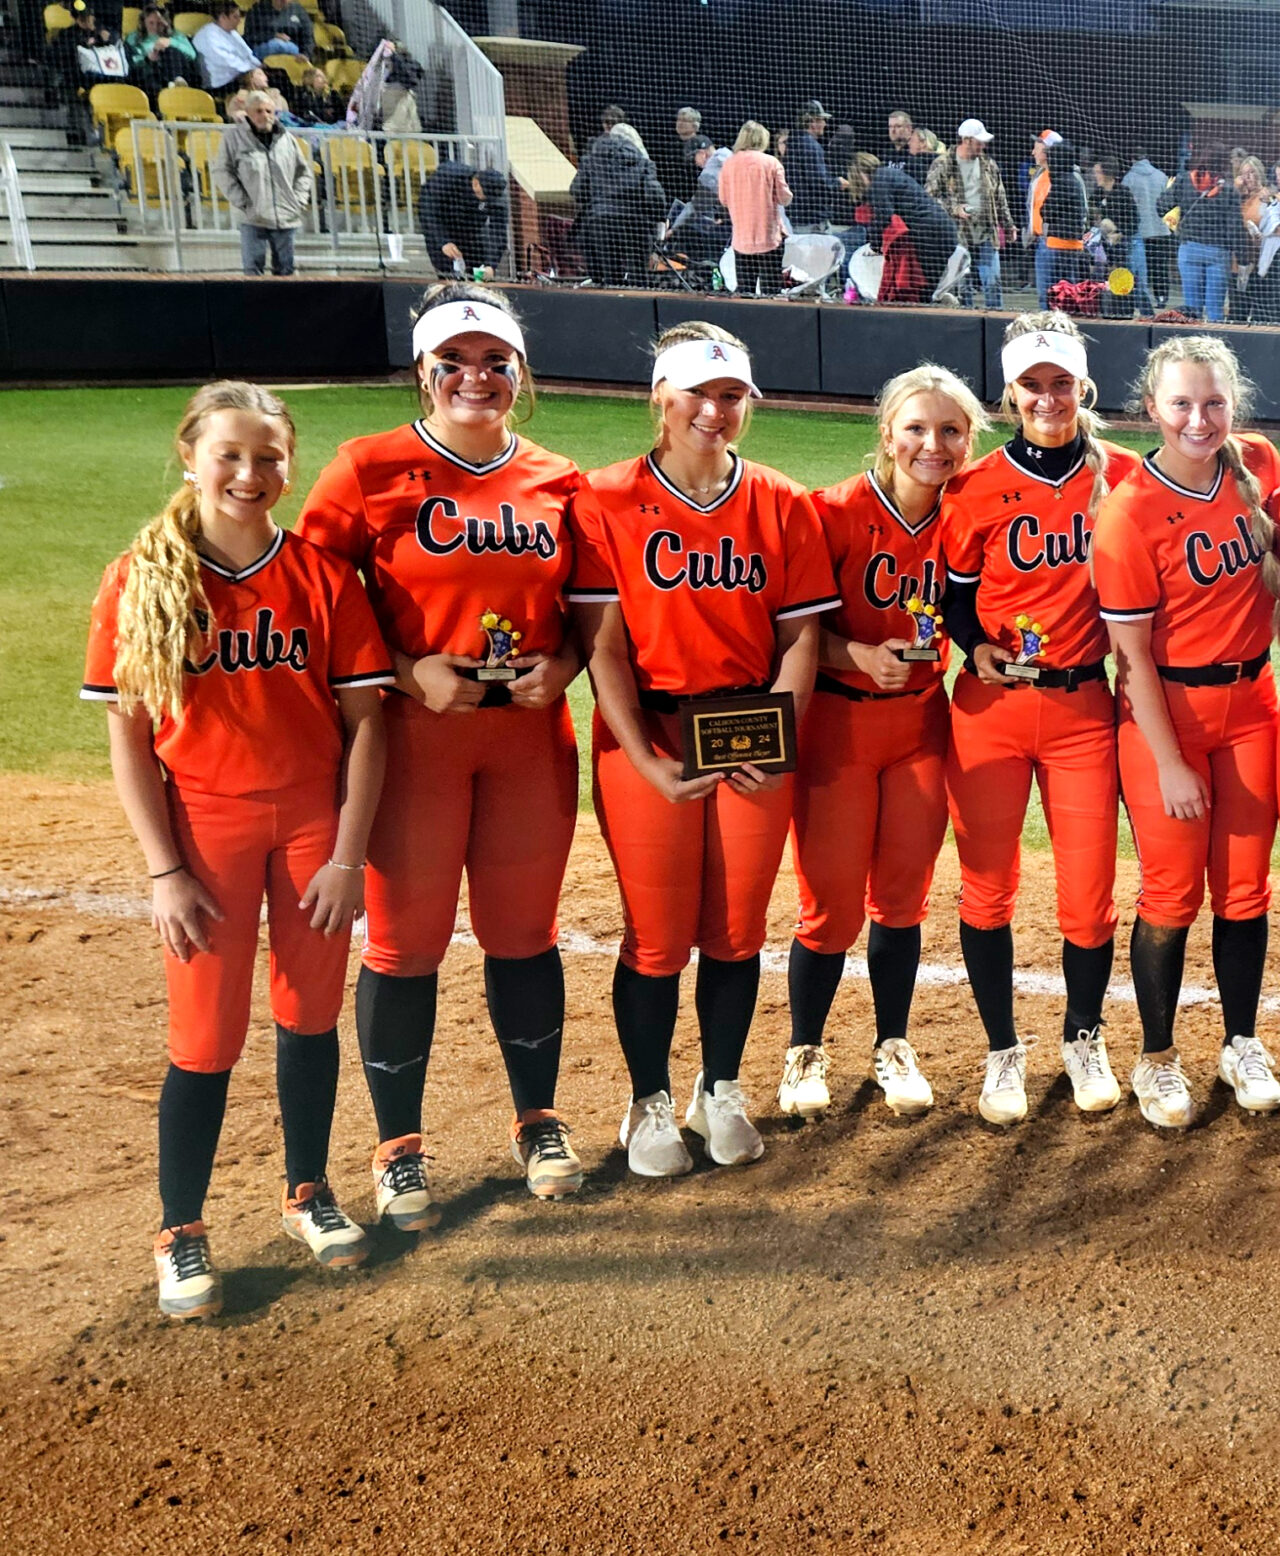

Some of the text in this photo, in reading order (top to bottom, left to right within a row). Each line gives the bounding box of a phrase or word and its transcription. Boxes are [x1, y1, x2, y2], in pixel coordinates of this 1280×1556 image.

[415, 495, 557, 561] Cubs
[1007, 512, 1092, 573] Cub
[1185, 514, 1266, 587] Cub
[643, 529, 768, 594] Cubs
[863, 551, 945, 611] Cub
